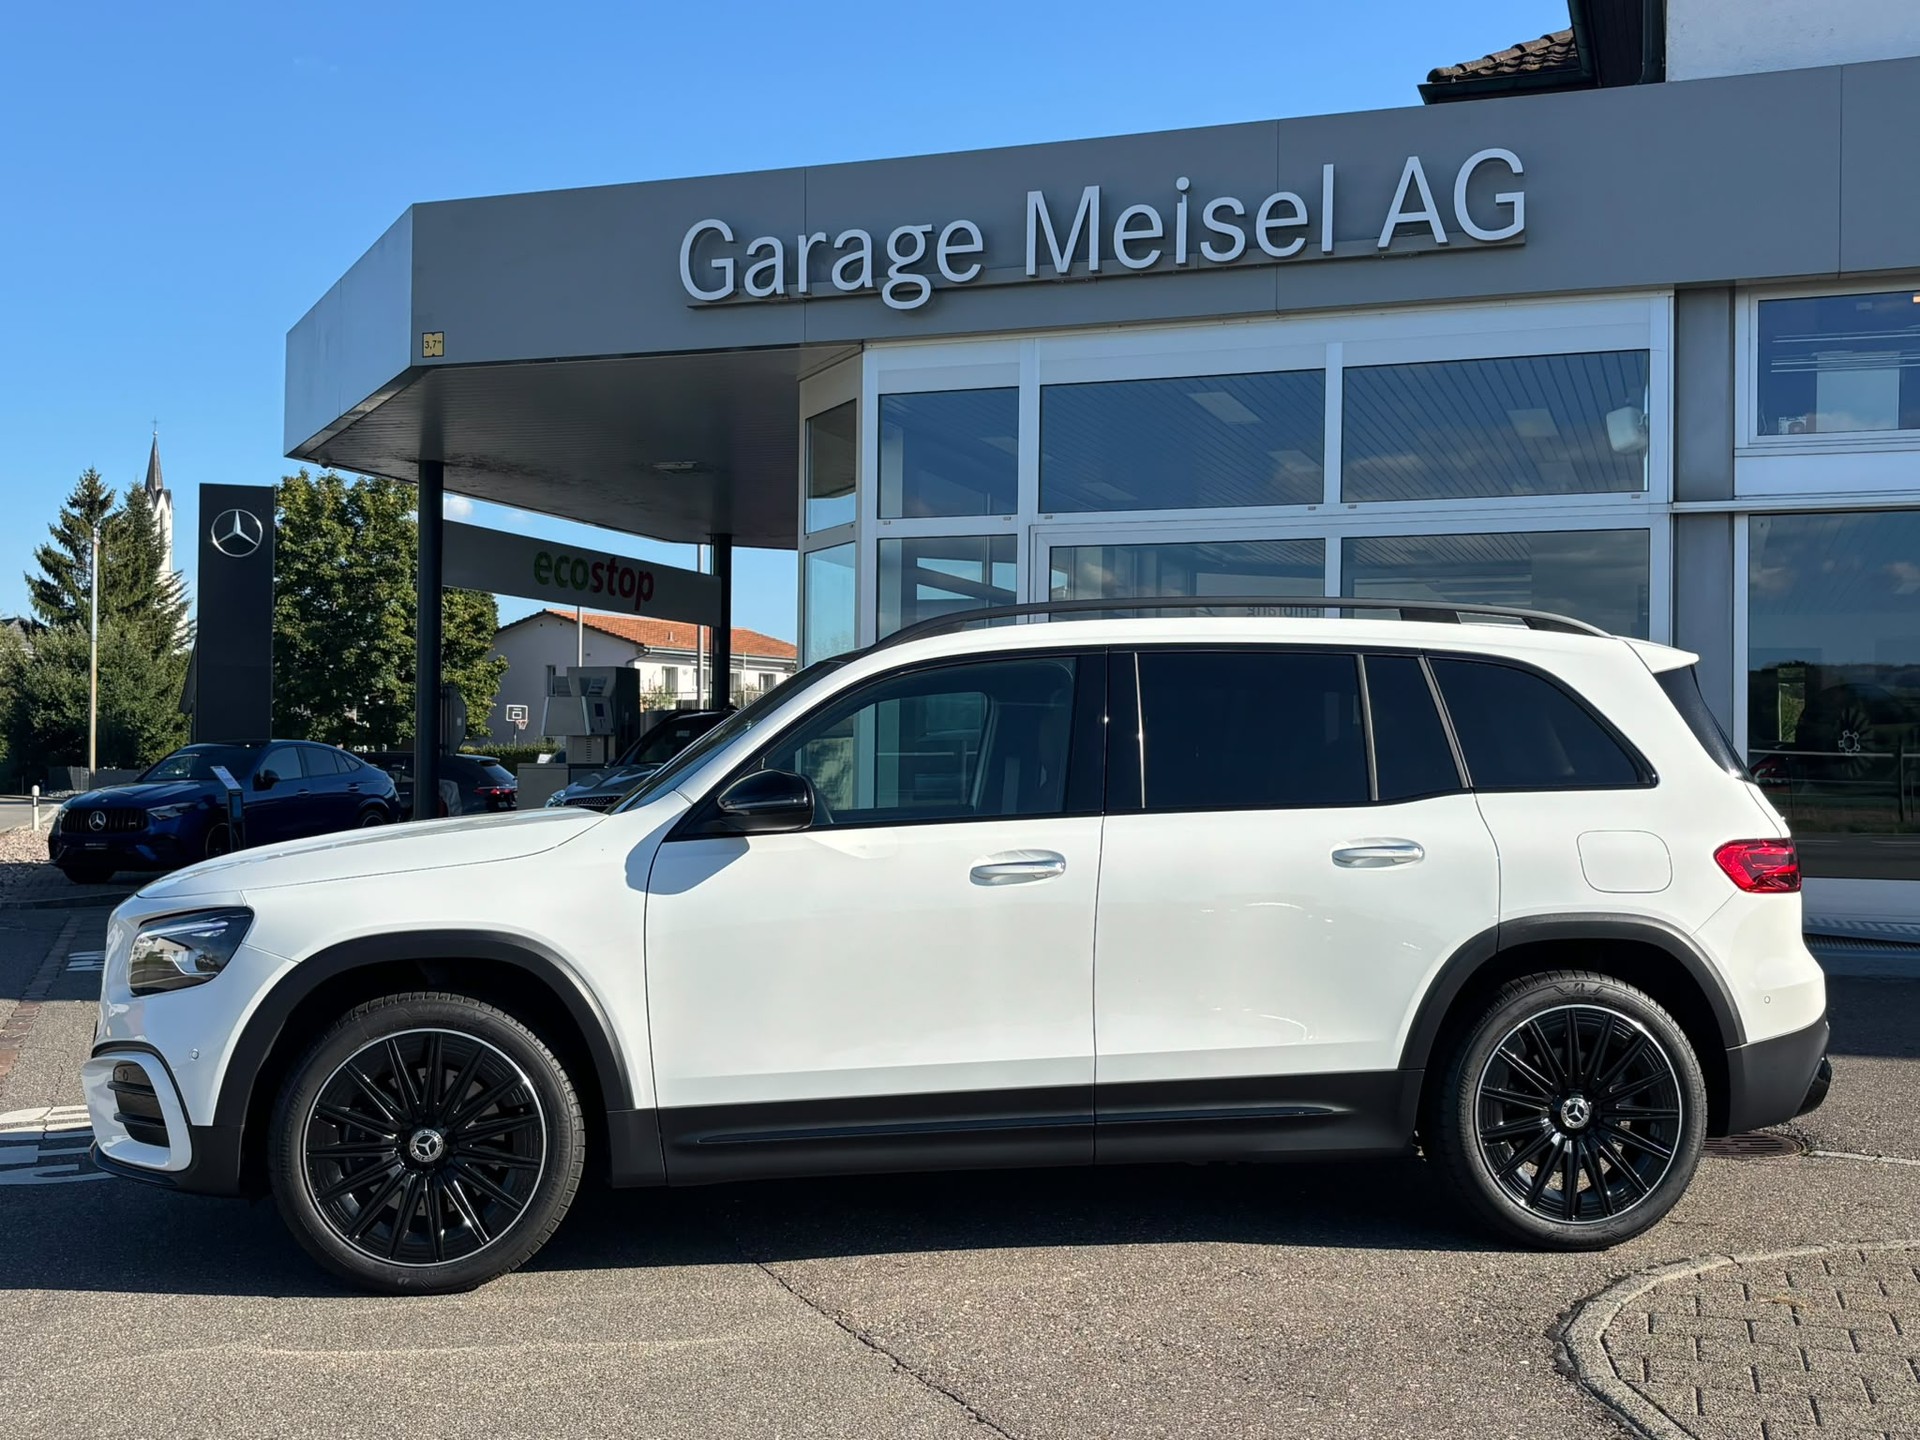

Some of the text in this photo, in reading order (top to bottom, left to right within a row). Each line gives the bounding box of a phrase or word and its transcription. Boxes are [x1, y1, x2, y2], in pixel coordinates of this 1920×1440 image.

[679, 148, 1525, 309] Garage Meisel AG
[533, 551, 655, 612] ecostop
